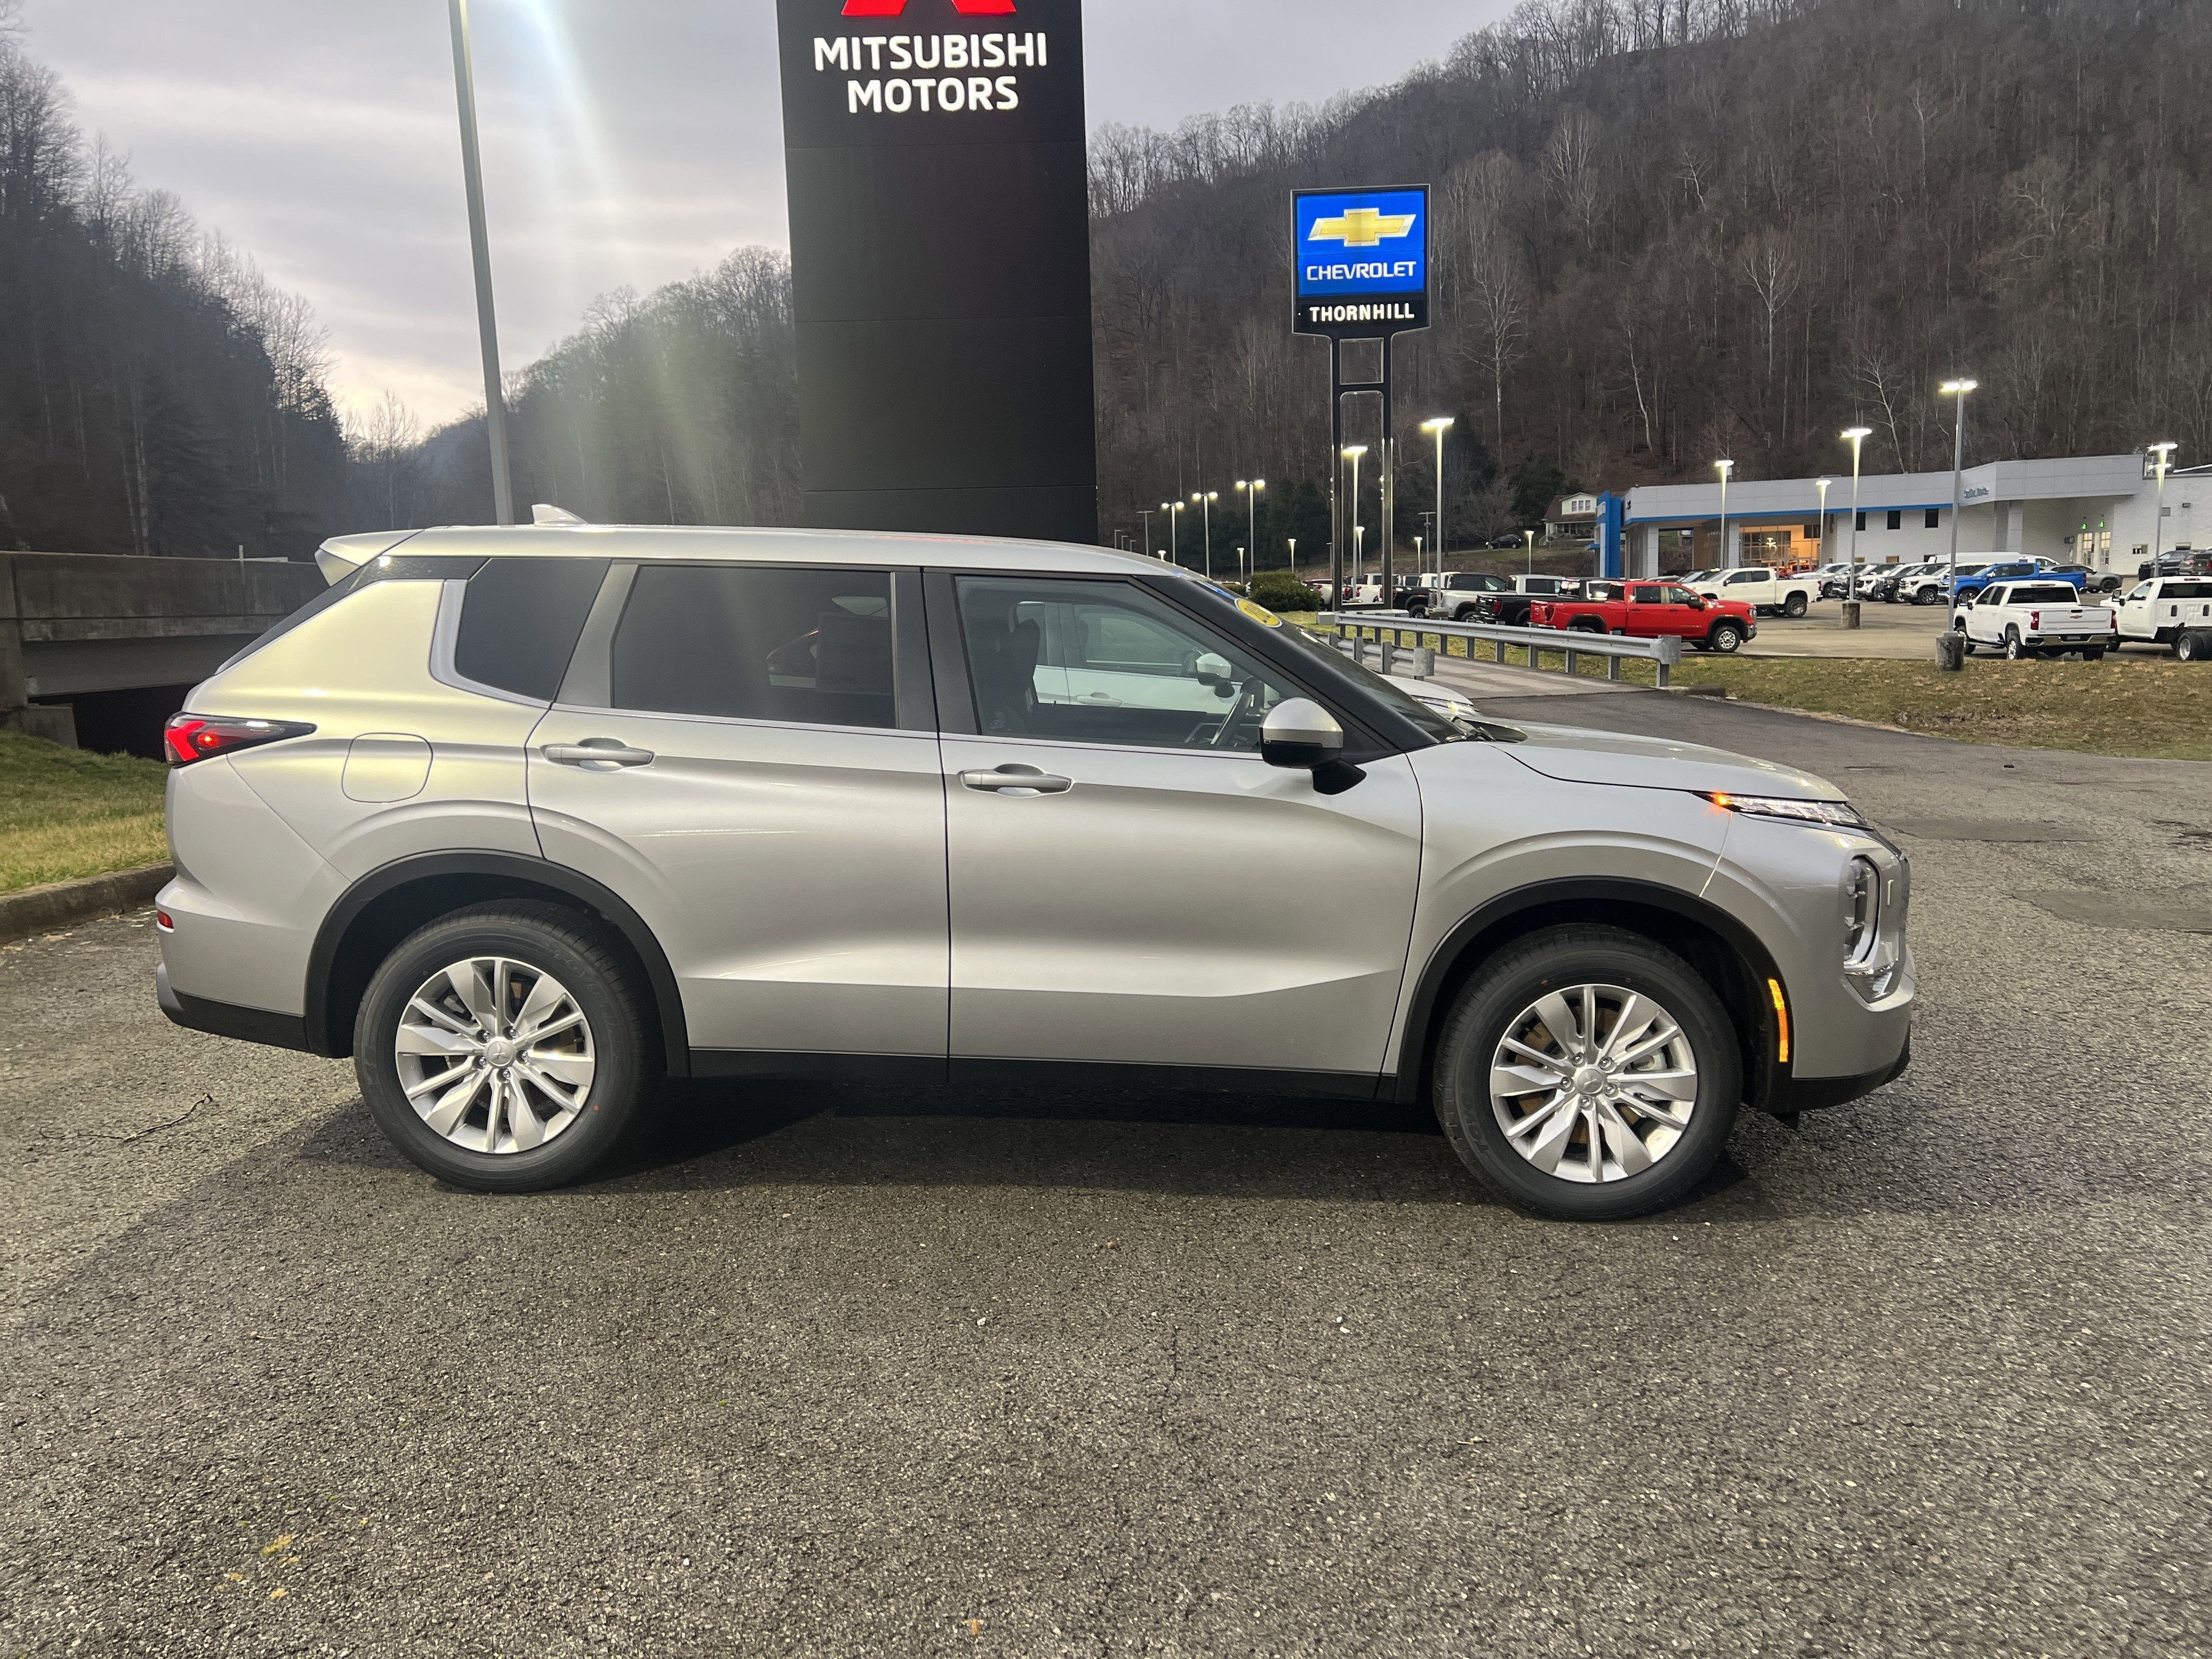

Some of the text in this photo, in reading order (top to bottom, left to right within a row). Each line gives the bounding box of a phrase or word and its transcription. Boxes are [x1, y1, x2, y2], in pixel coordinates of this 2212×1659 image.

[814, 32, 1047, 71] MITSUBISHI
[847, 76, 1019, 113] MOTORS
[1306, 261, 1417, 280] CHEVROLET
[1310, 302, 1415, 322] THORNHILL
